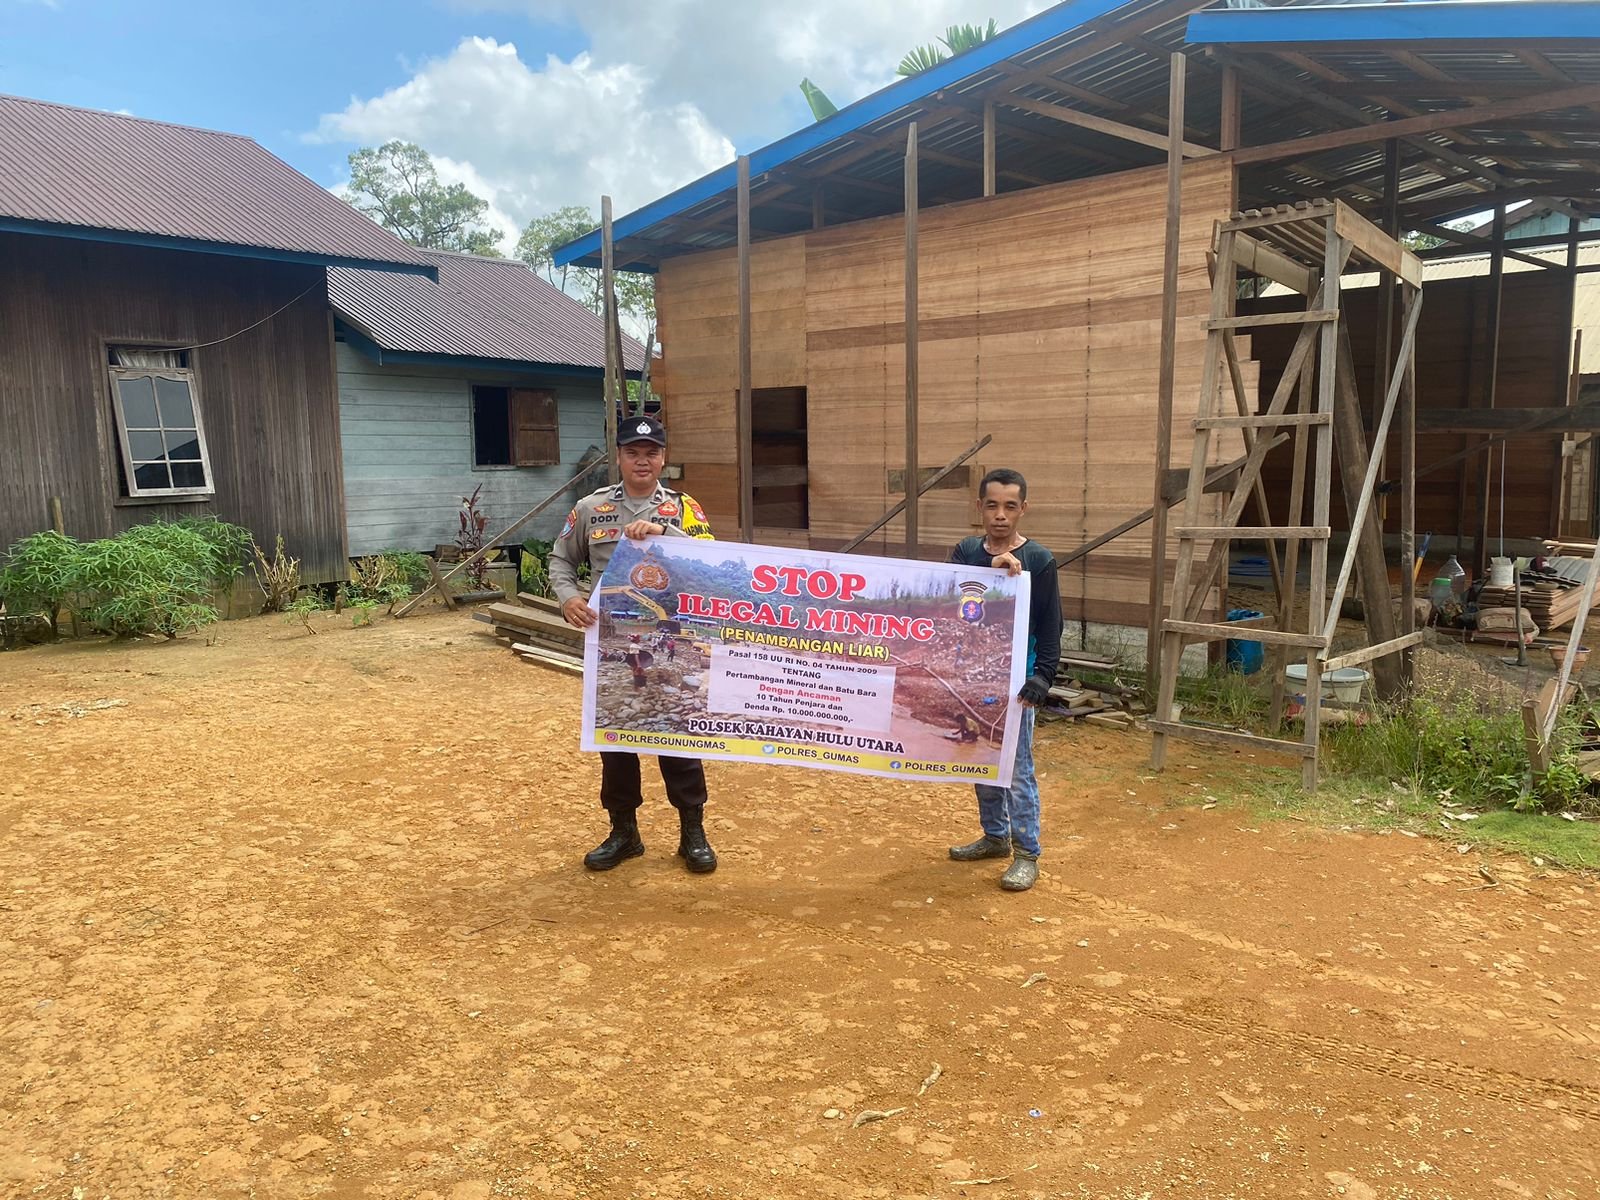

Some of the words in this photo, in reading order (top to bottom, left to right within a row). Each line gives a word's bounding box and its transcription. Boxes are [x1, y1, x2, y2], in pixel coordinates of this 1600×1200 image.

[591, 515, 619, 524] DODY
[751, 564, 867, 601] STOP
[677, 592, 799, 629] ILEGAL
[804, 608, 936, 641] MINING
[720, 627, 844, 655] (PENAMBANGAN
[849, 643, 890, 661] LIAR)
[728, 650, 751, 658] Pasal
[753, 652, 768, 661] 158
[770, 654, 782, 663] UU
[785, 656, 794, 664] RI
[796, 658, 810, 667] NO.
[813, 661, 823, 669] 04
[825, 663, 855, 672] TAHUN
[857, 667, 878, 675] 2009
[782, 667, 821, 679] TENTANG
[726, 670, 785, 685] Pertambangan
[786, 679, 816, 689] Mineral
[818, 683, 833, 692] dan
[835, 686, 855, 695] Batu
[857, 688, 877, 697] Bara
[759, 684, 794, 697] Dengan
[797, 690, 841, 702] Ancaman
[756, 693, 766, 701] 10
[768, 694, 793, 704] Tahun
[795, 699, 826, 710] Penjara
[828, 703, 843, 711] dan
[744, 702, 770, 711] Denda
[772, 705, 785, 715] Rp.
[788, 708, 854, 723] 10.000.000.000,-
[619, 733, 731, 753] POLRESGUNUNGMAS_
[689, 719, 744, 734] POLSEK
[745, 722, 814, 741] KAHAYAN
[816, 731, 854, 746] HULU
[857, 737, 905, 754] UTARA
[777, 746, 860, 764] POLRES_GUMAS
[905, 762, 989, 775] POLRES_GUMAS
